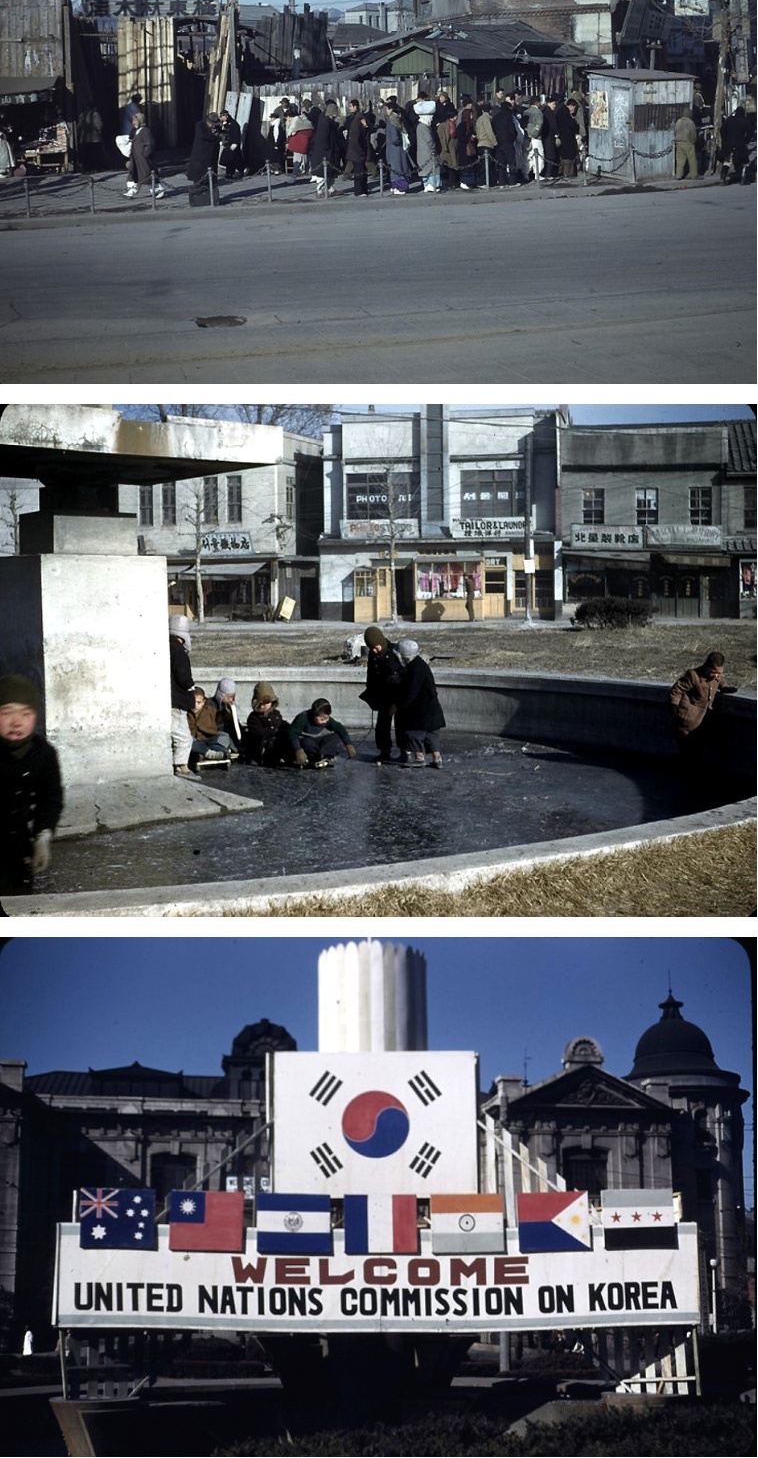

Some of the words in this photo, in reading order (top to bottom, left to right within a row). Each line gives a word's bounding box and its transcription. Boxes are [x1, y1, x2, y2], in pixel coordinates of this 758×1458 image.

[231, 1256, 530, 1286] WELCOME
[74, 1281, 183, 1312] UNITED
[199, 1284, 324, 1316] NATIONS
[340, 1285, 524, 1316] COMMISSION
[538, 1284, 575, 1313] ON
[588, 1281, 678, 1311] KOREA
